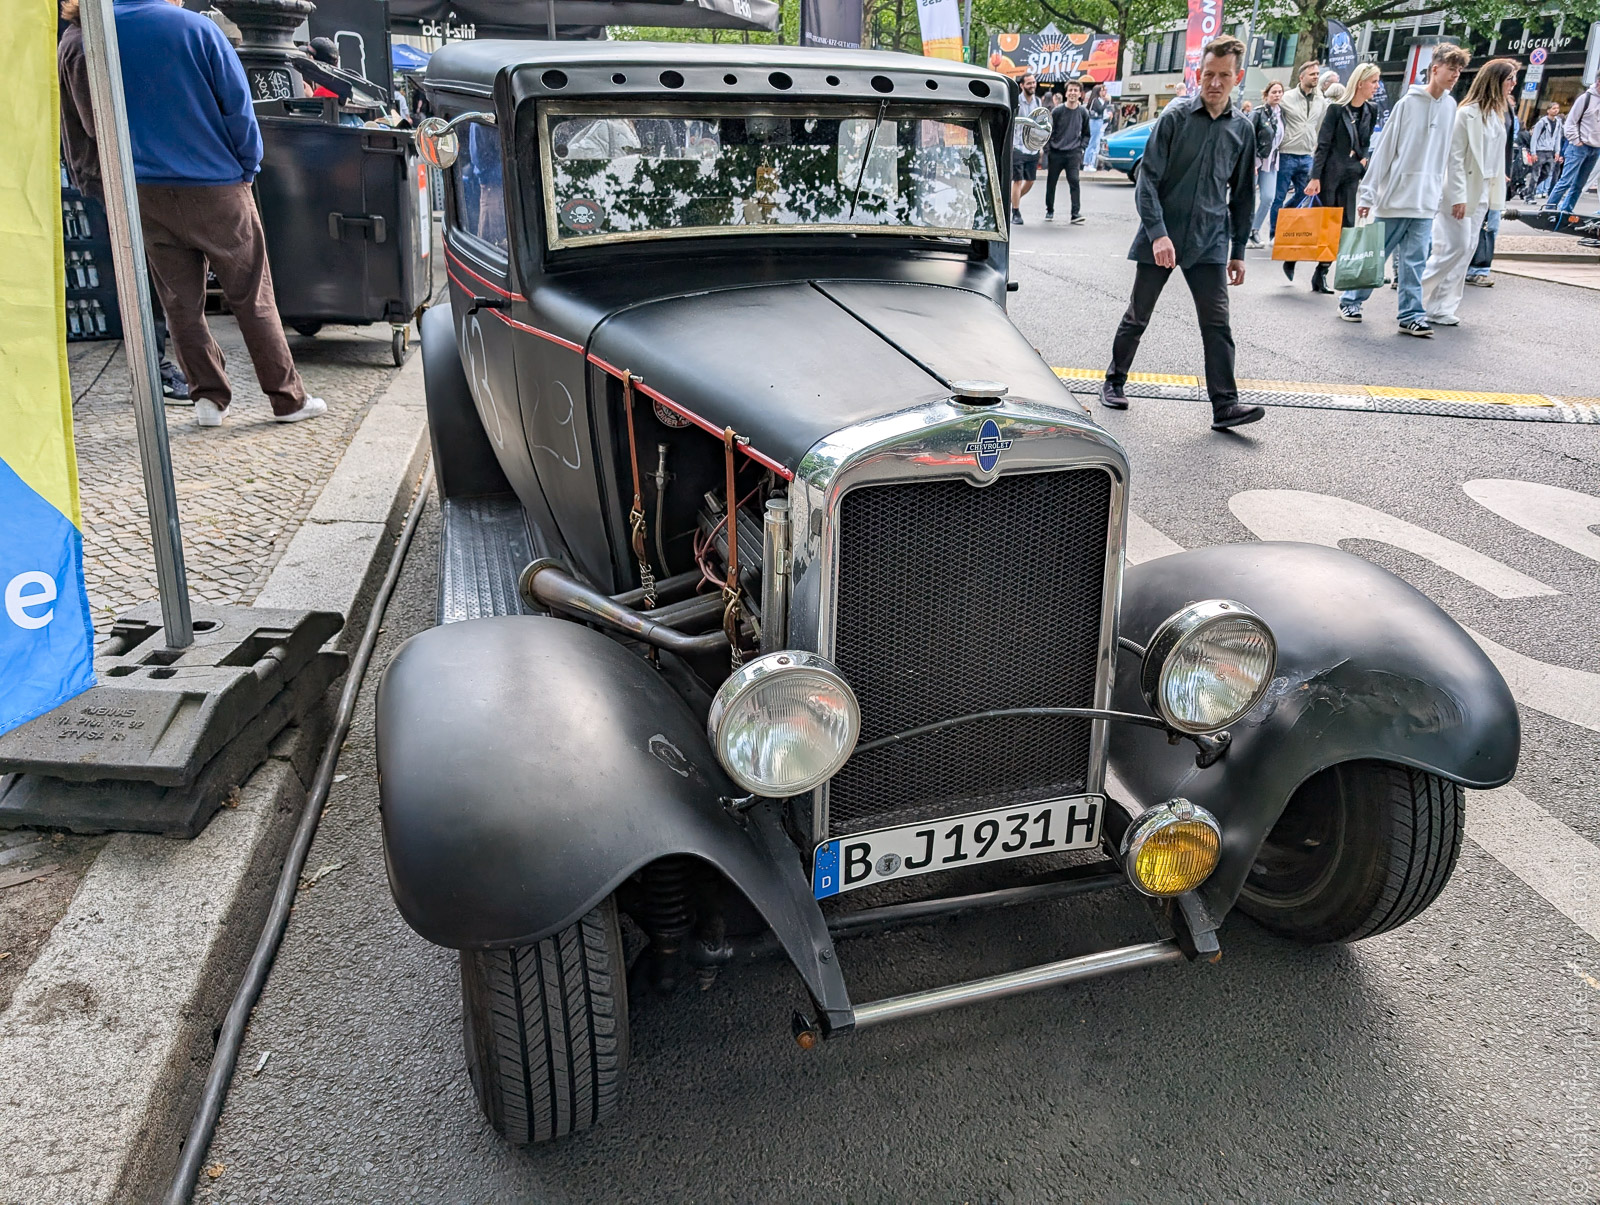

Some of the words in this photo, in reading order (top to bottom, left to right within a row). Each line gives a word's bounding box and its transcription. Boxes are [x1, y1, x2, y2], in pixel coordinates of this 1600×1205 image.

[1508, 37, 1571, 49] LONGCHAMP
[970, 442, 1010, 451] CHEVROLET
[844, 843, 872, 885] B
[822, 876, 831, 888] D
